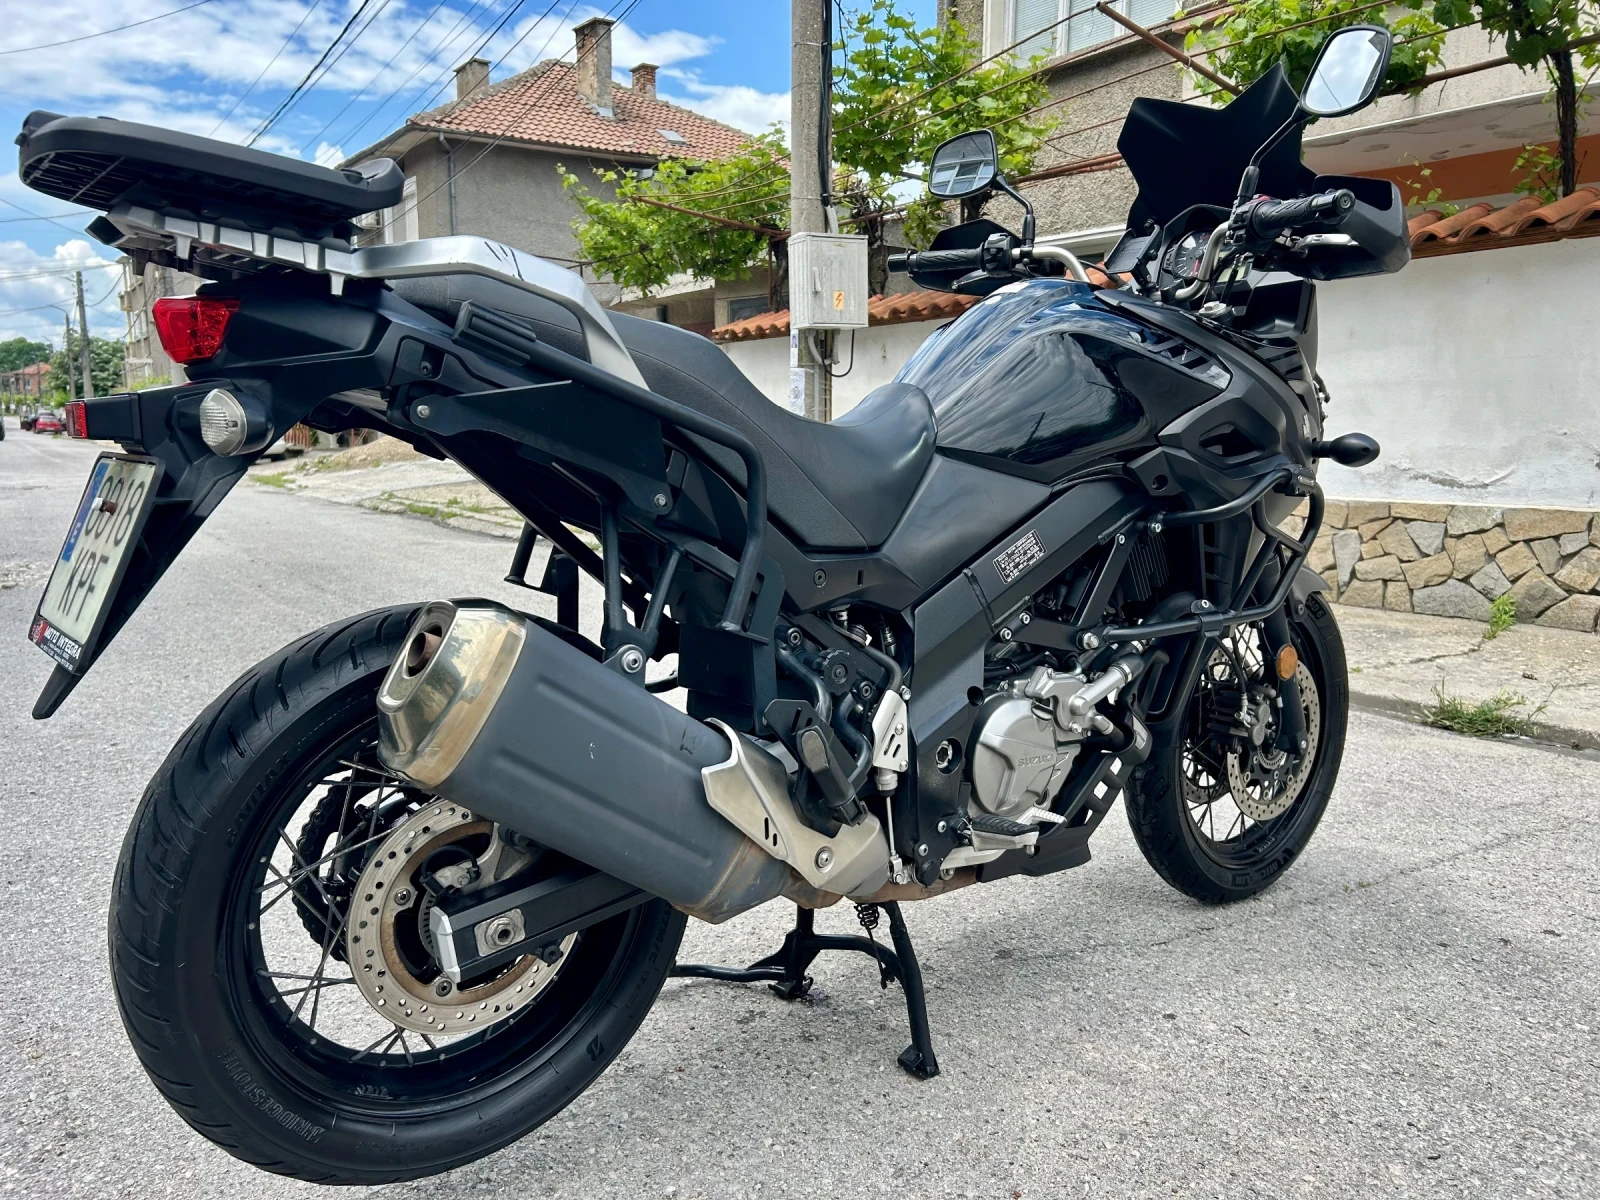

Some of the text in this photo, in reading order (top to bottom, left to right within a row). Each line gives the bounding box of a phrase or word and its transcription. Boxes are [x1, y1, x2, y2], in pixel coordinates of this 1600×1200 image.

[57, 547, 109, 622] KPF
[57, 634, 82, 660] INTEGRA
[1018, 753, 1055, 769] SUZUKI
[216, 1048, 327, 1145] BRIDGESTONE
